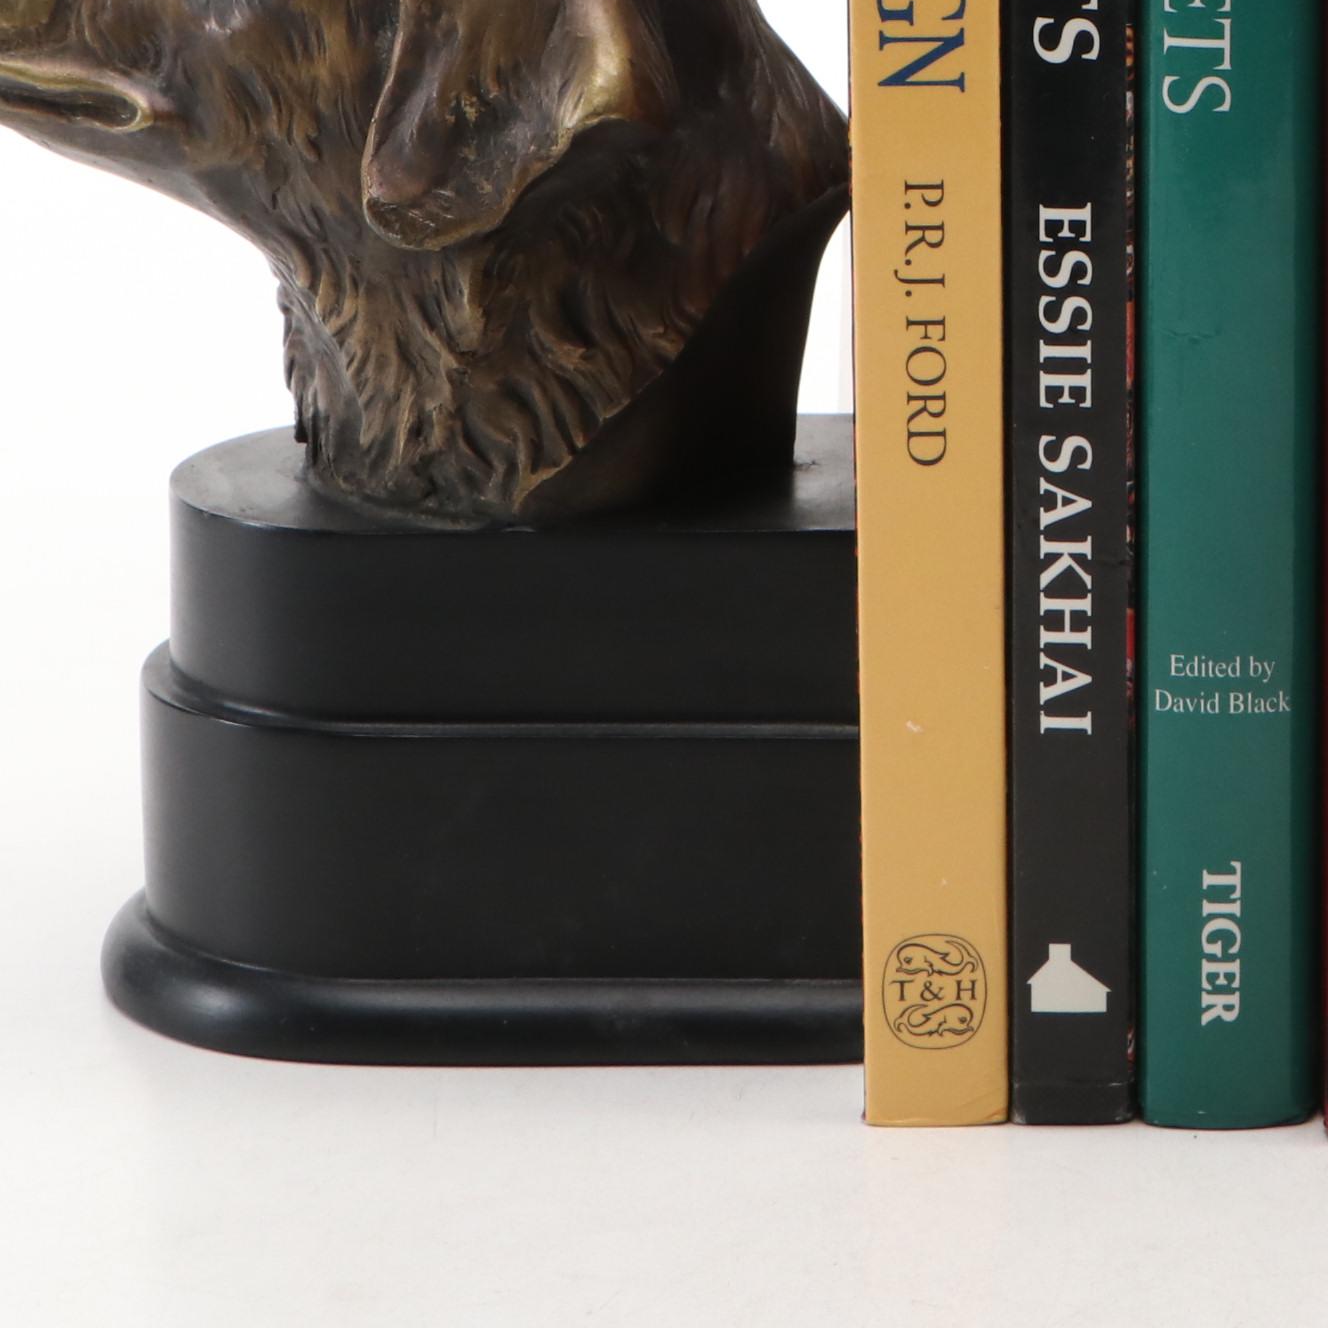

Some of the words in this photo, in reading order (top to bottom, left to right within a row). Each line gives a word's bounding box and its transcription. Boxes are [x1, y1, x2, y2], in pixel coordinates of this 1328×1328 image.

[1037, 202, 1092, 409] ESSIE
[905, 316, 947, 467] FORD
[1037, 434, 1092, 736] SAKHAI
[1154, 688, 1219, 714] David
[1228, 689, 1292, 714] Black
[1170, 654, 1240, 679] Edited
[1248, 656, 1275, 684] by
[1201, 860, 1242, 1026] TIGER
